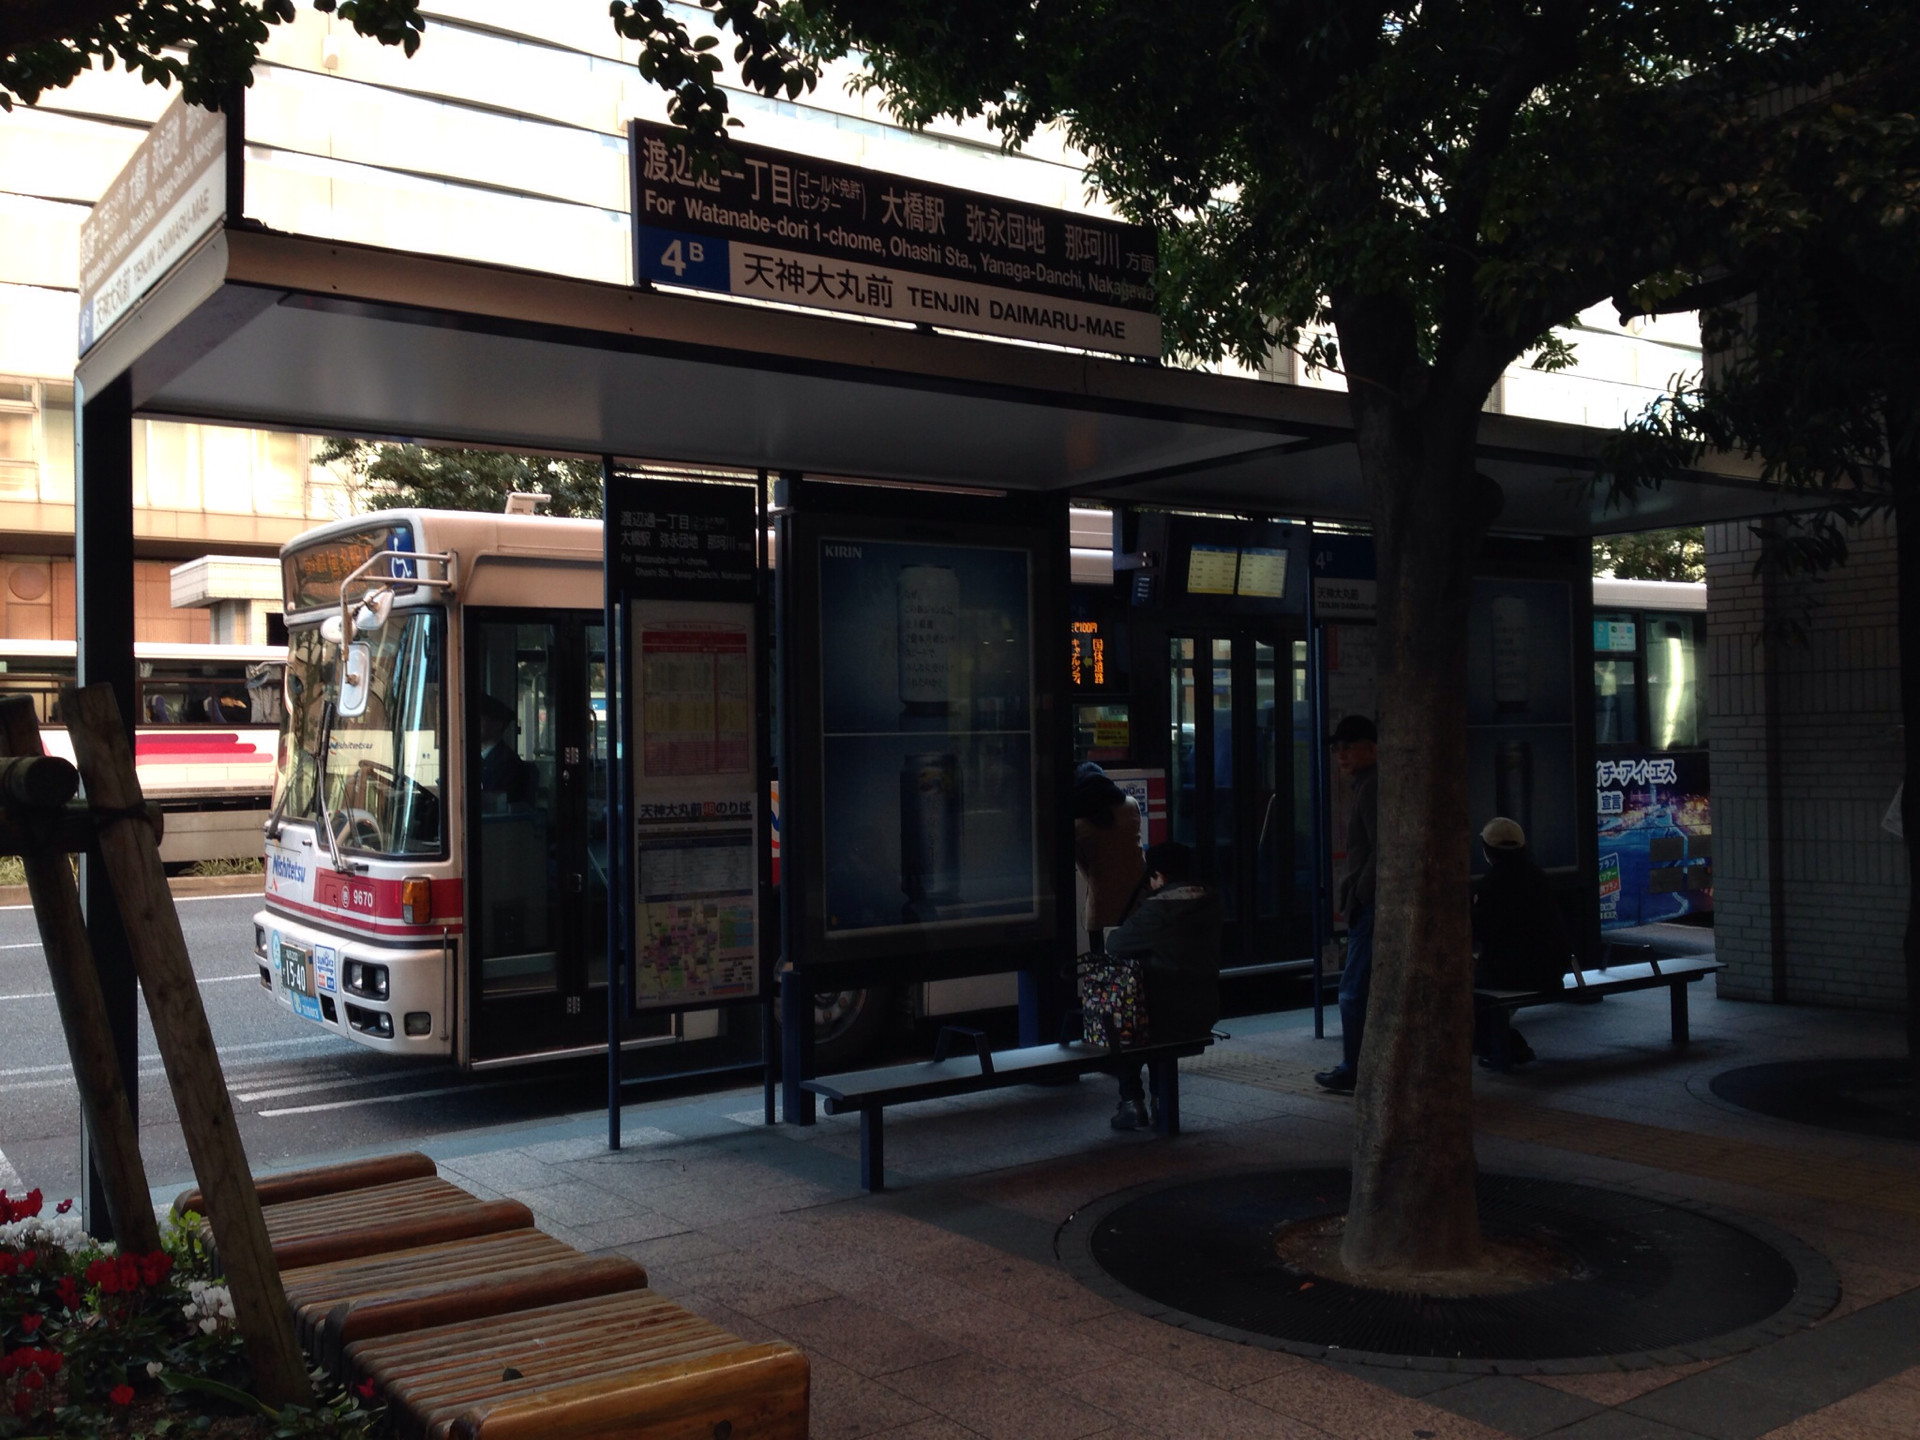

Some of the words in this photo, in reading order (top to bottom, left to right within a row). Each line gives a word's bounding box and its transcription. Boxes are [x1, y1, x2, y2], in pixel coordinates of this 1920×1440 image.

[644, 190, 676, 216] For
[684, 197, 809, 240] Watanabe-dori
[813, 221, 887, 255] 1-chome,
[889, 235, 941, 263] Ohashi
[945, 246, 978, 274] Sta.,
[980, 253, 1086, 291] Yanaga-Danchi,
[881, 187, 946, 236] 大橋駅
[965, 203, 1046, 255] 弥永団地
[1065, 223, 1120, 269] 那珂川
[1126, 251, 1156, 273] 方面
[660, 239, 704, 277] 4B
[744, 252, 893, 309] 天神大丸前
[907, 286, 979, 316] TENJIN
[990, 300, 1125, 340] DAIMARU-MAE
[824, 545, 863, 560] KIRIN
[272, 853, 307, 883] Nishitetsu
[353, 889, 373, 908] 9670
[285, 959, 306, 991] 15-40
